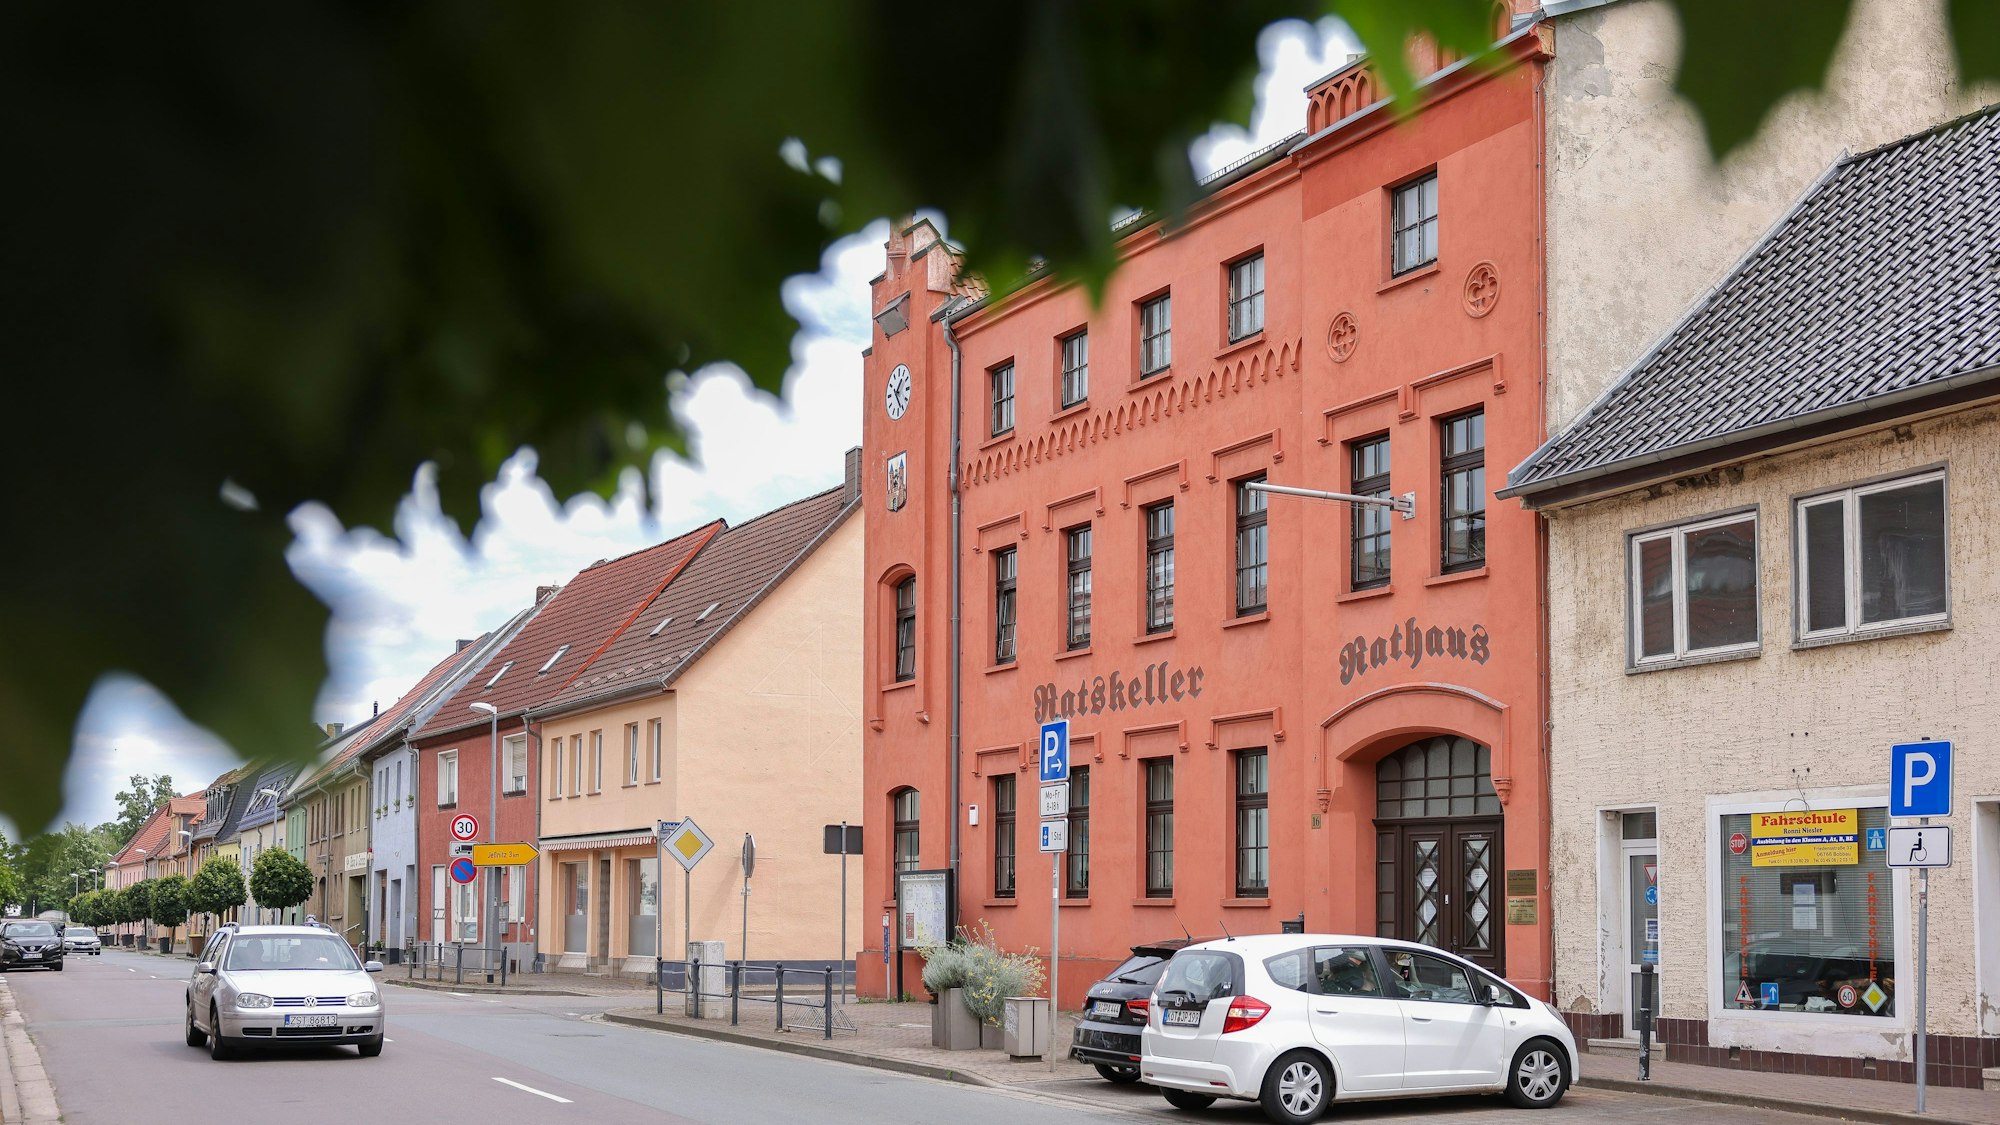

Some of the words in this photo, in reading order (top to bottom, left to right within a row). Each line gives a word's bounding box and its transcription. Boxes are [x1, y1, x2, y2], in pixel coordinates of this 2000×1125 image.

[1339, 616, 1491, 686] Rathaus
[1033, 660, 1205, 724] Ratskeller
[1044, 730, 1059, 774] P
[1904, 752, 1937, 807] P
[1312, 816, 1320, 826] 16
[1761, 812, 1846, 826] Fahrschule
[456, 821, 473, 834] 30
[1730, 839, 1745, 848] STOP
[1756, 848, 1785, 858] Anmeldung
[1843, 992, 1853, 1001] 60
